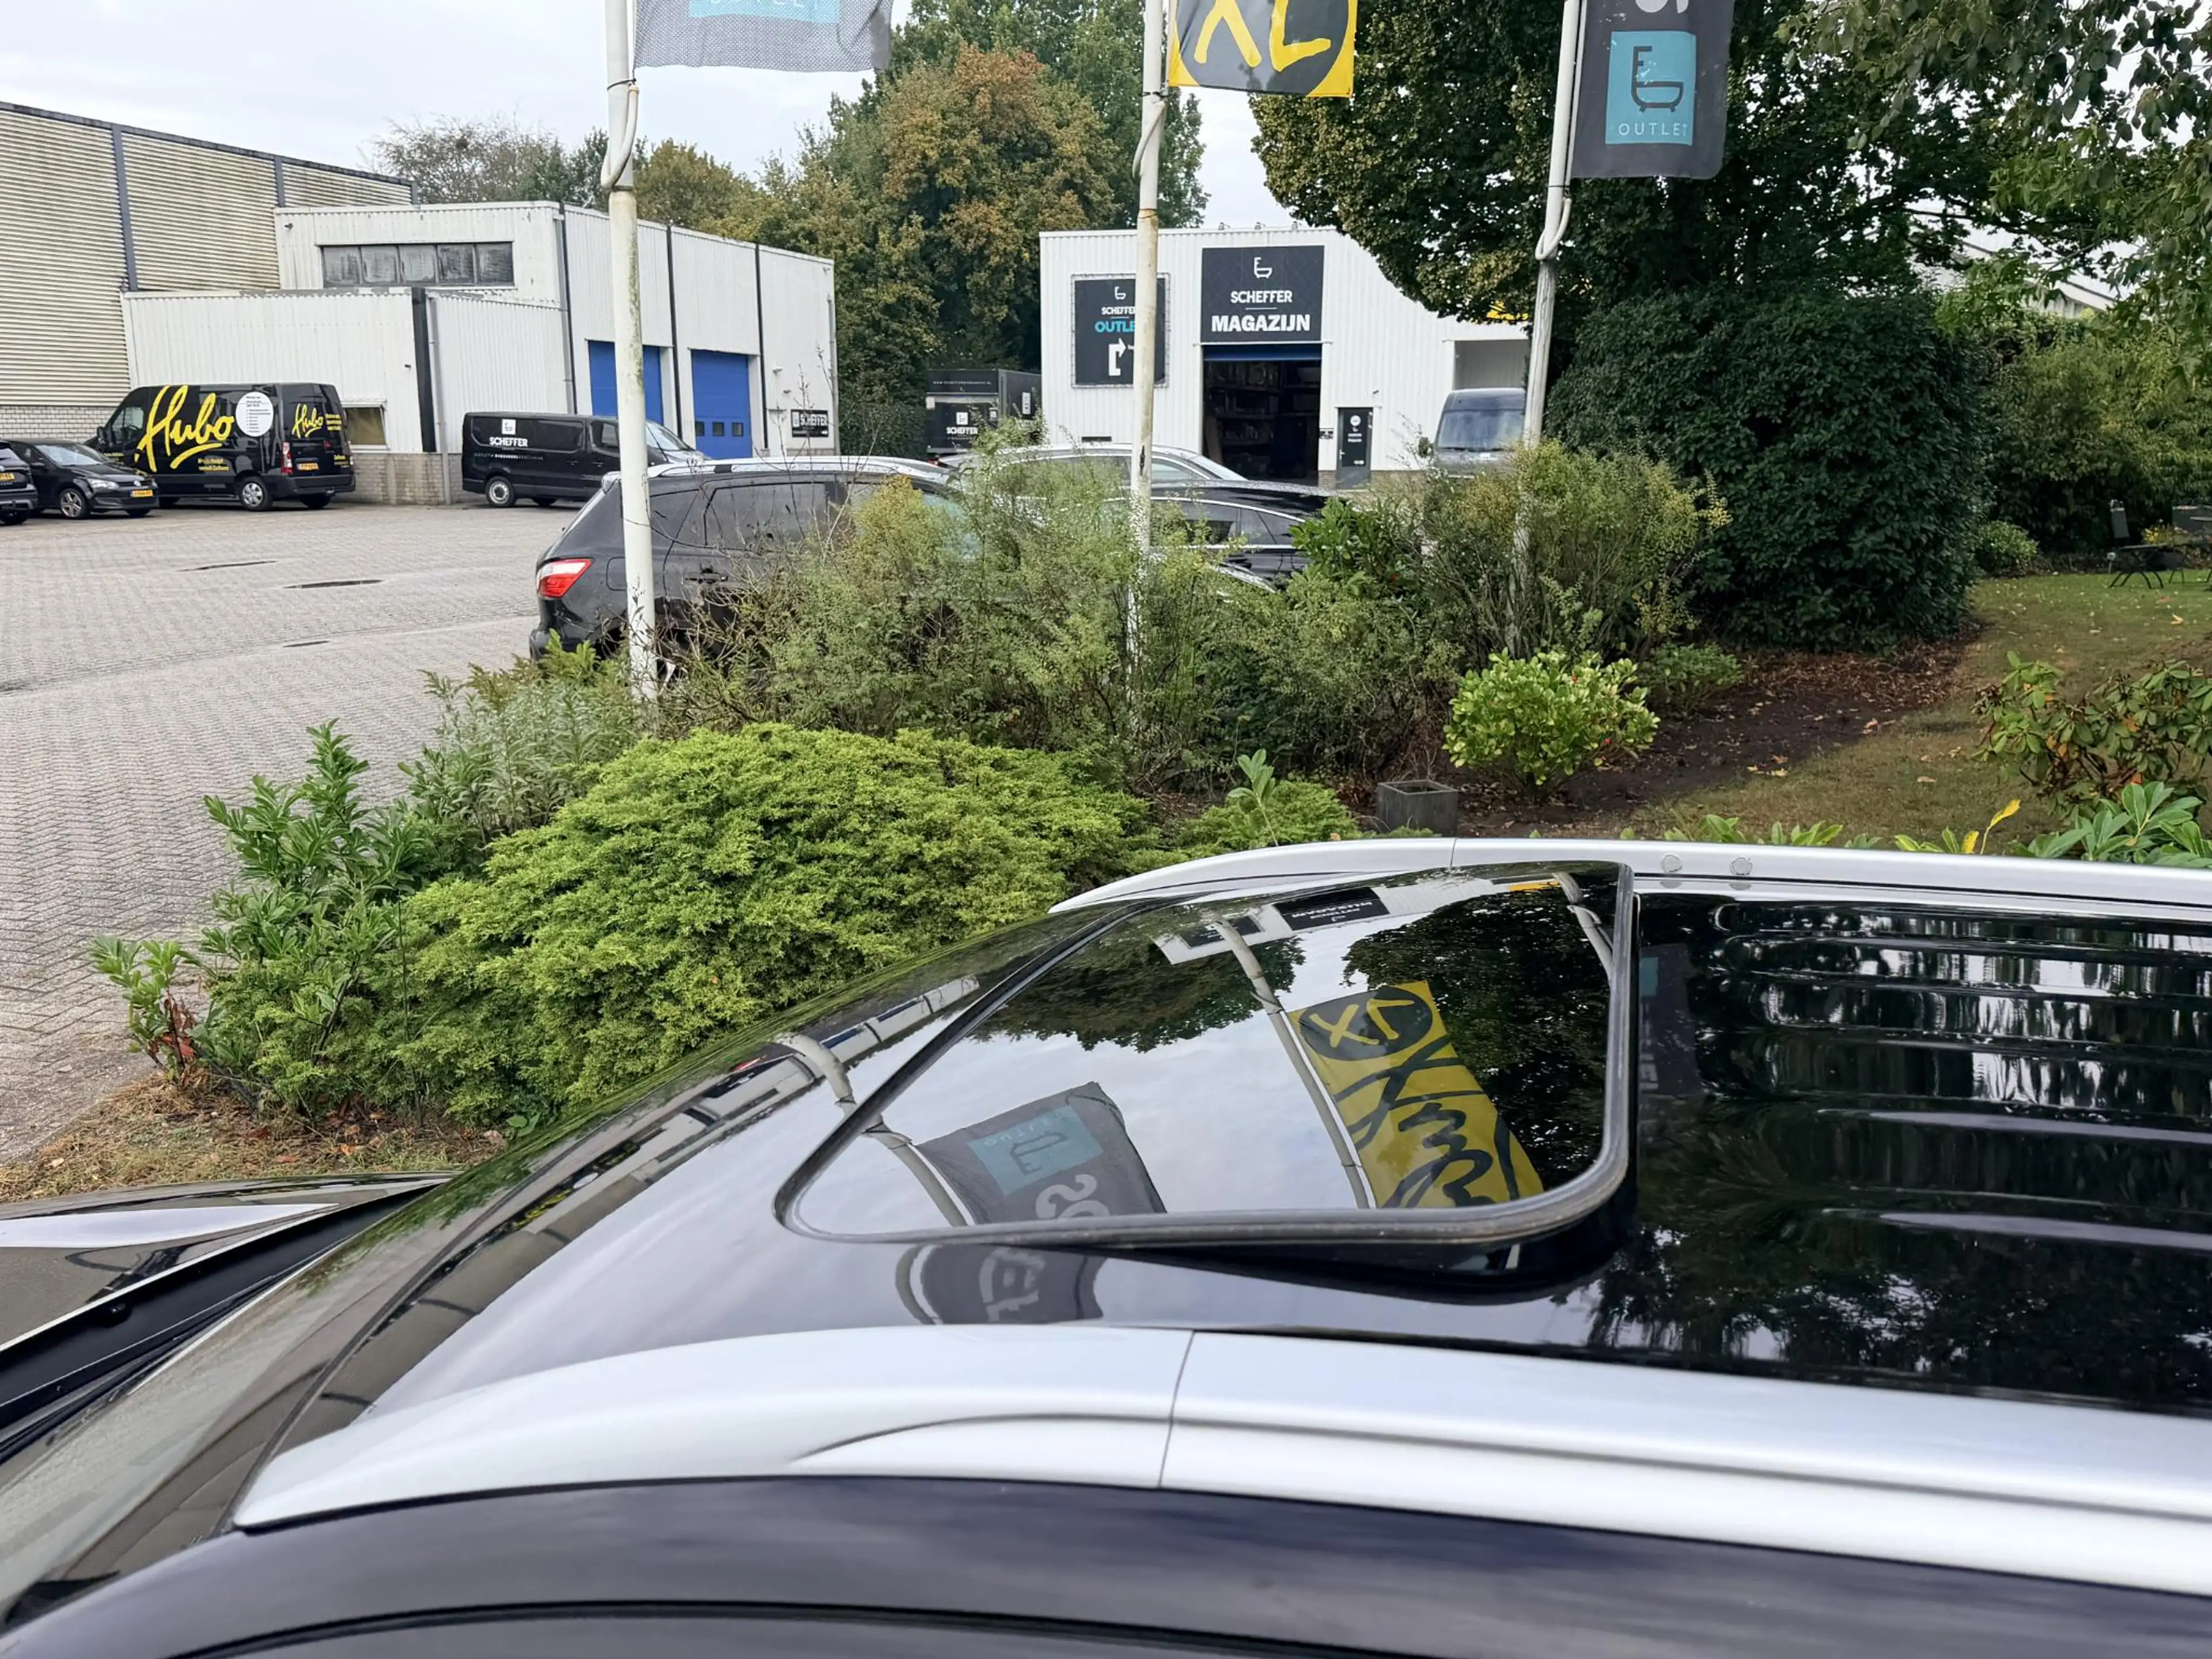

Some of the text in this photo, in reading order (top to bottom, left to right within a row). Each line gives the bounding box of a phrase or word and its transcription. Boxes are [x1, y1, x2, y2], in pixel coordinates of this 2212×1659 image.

[1618, 122, 1687, 137] OUTLET
[1230, 290, 1293, 304] SCHEFFER
[1101, 306, 1135, 316] SCHEFFE
[1094, 320, 1135, 333] OUTLE
[1211, 314, 1310, 332] MAGAZIJN
[291, 403, 324, 438] Hubo
[134, 385, 235, 472] Hubo
[489, 436, 528, 447] SCHEFFER
